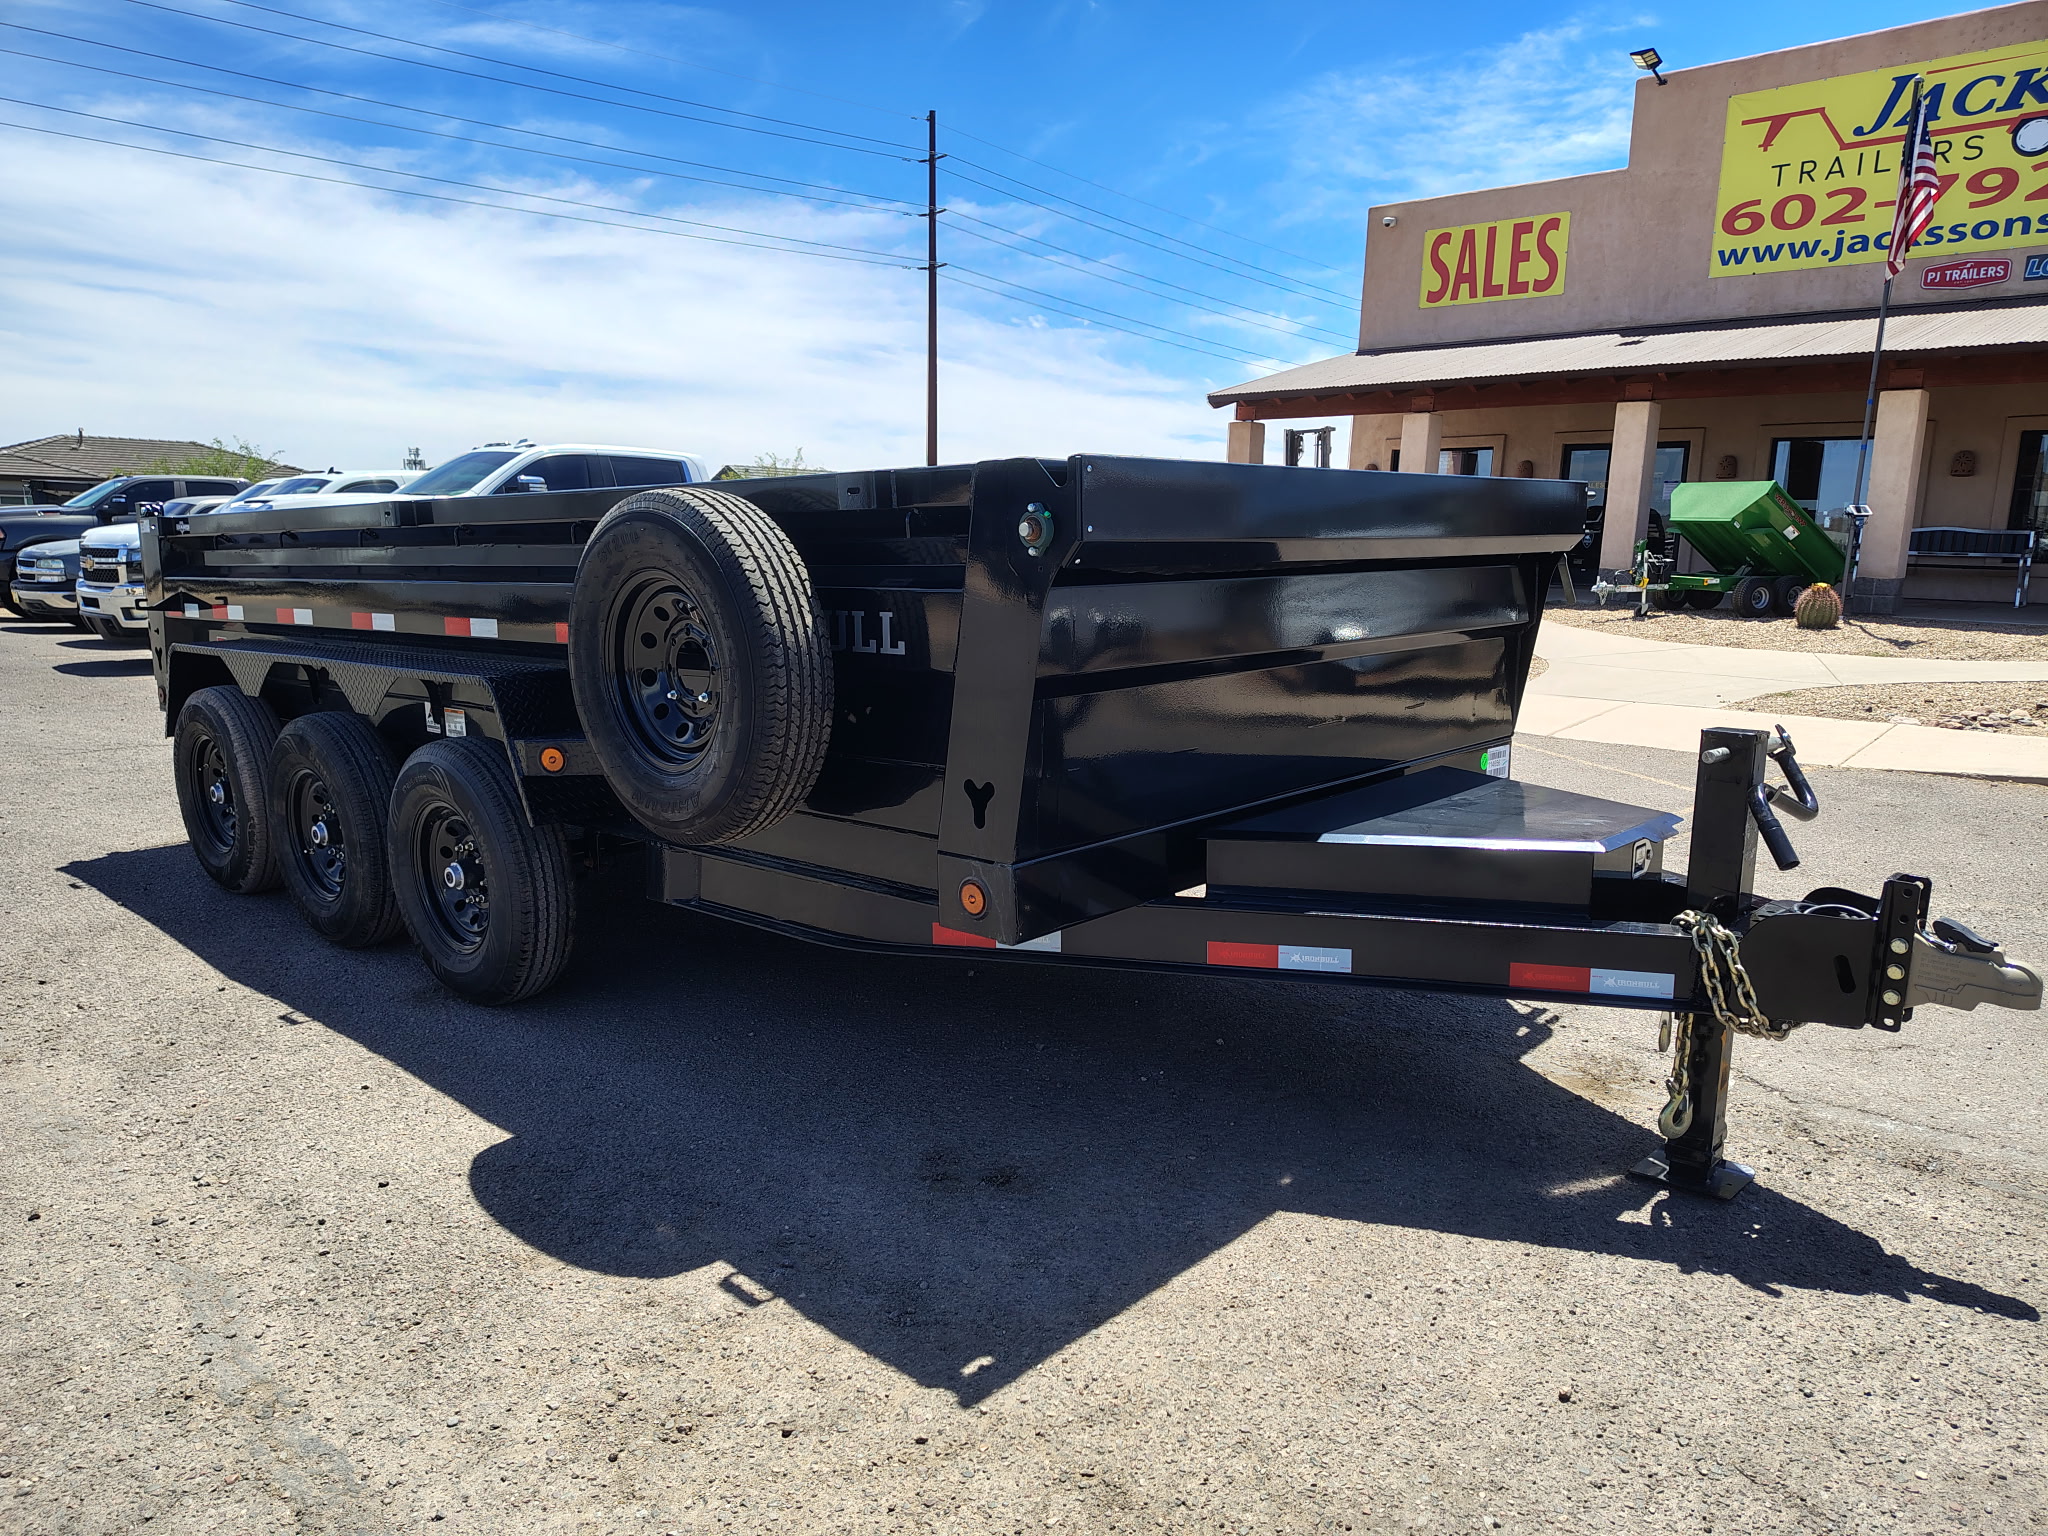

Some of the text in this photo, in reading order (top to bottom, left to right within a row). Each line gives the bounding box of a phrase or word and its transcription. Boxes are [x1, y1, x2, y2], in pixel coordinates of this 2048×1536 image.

[1771, 135, 1985, 187] TRAILRS
[1426, 217, 1562, 304] SALES
[1927, 272, 1941, 283] PJ
[1945, 265, 2005, 282] TRAILERS
[1302, 954, 1340, 964] IRONBULL
[1617, 979, 1661, 989] IRONBULL
